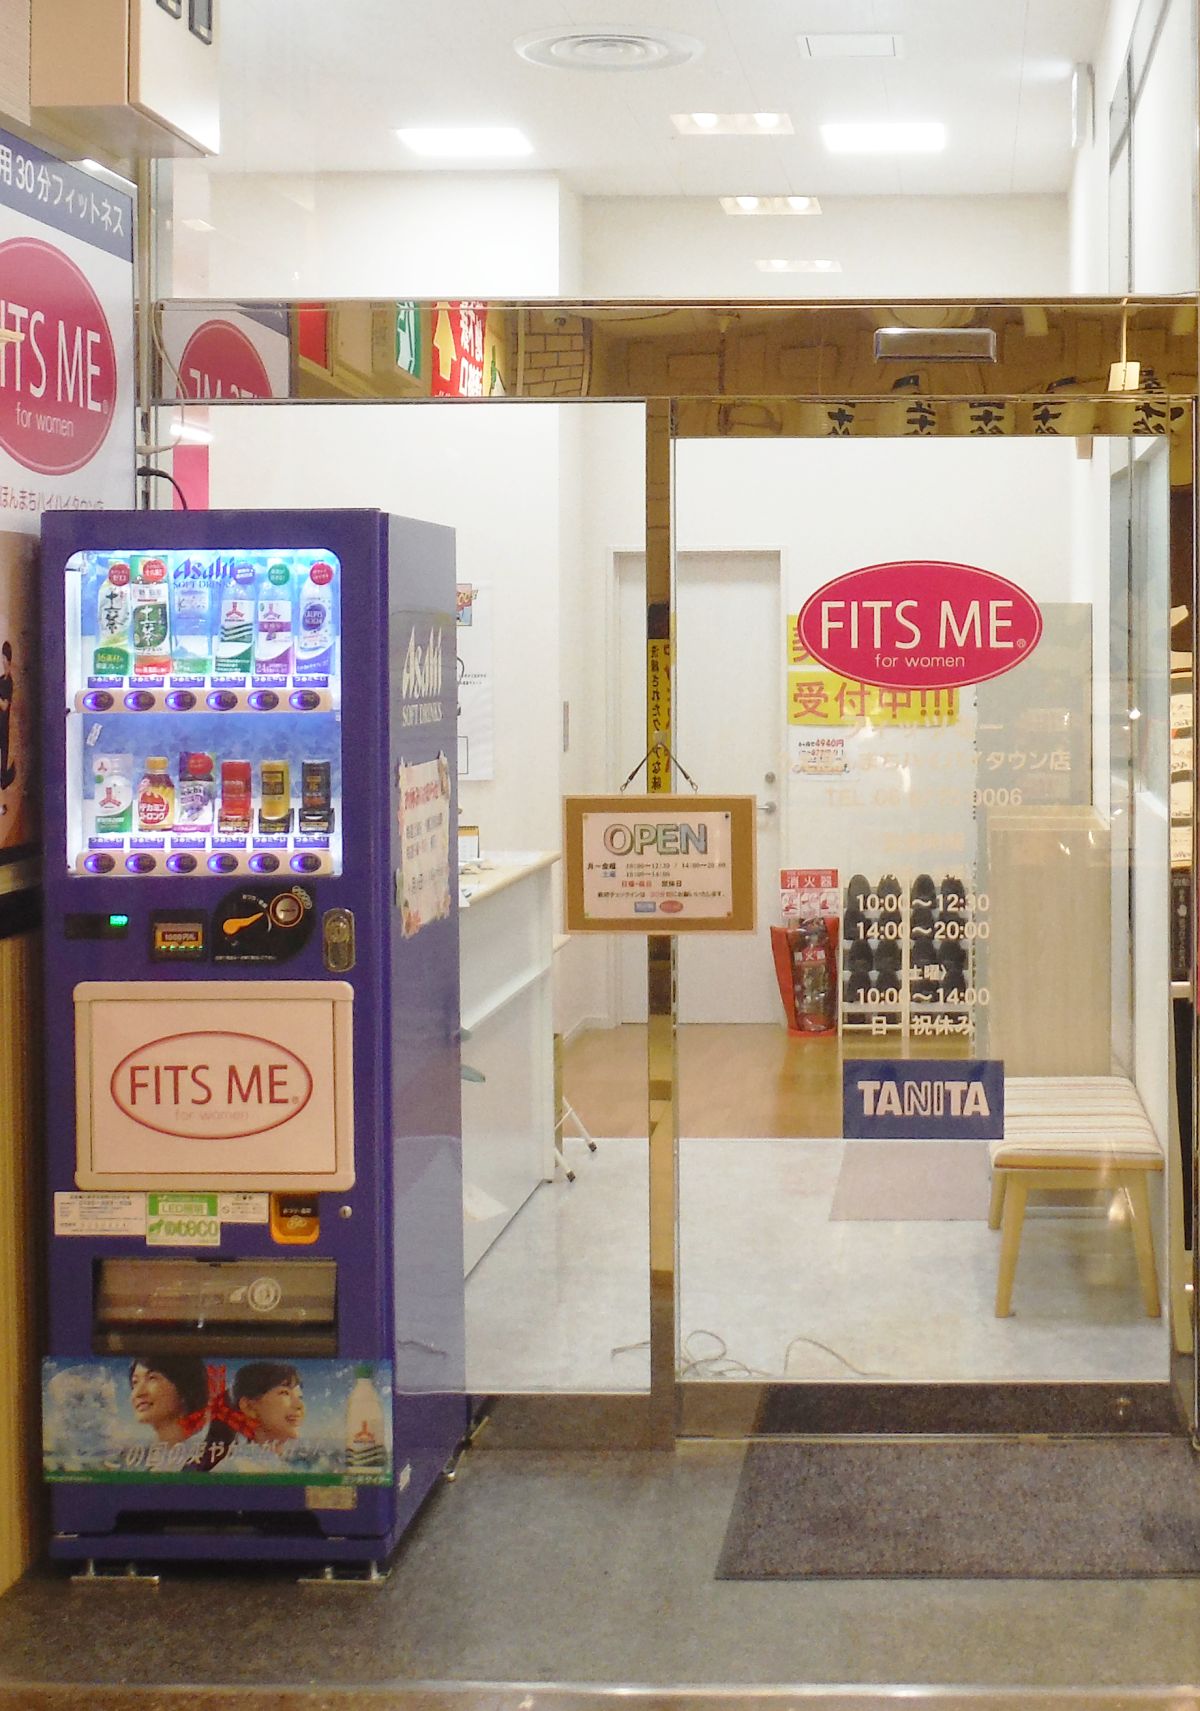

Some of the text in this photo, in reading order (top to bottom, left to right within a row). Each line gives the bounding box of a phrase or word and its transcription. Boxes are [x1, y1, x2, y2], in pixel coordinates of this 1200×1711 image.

[57, 320, 101, 412] ME
[16, 402, 75, 437] for women
[821, 600, 921, 649] FITS
[939, 600, 1014, 649] ME
[402, 626, 442, 699] Asahi
[875, 654, 965, 668] for women
[603, 823, 708, 856] OPEN
[787, 875, 833, 888] 消火器
[129, 1064, 289, 1106] FITS ME
[857, 1081, 990, 1116] TANITA
[201, 1111, 249, 1121] women
